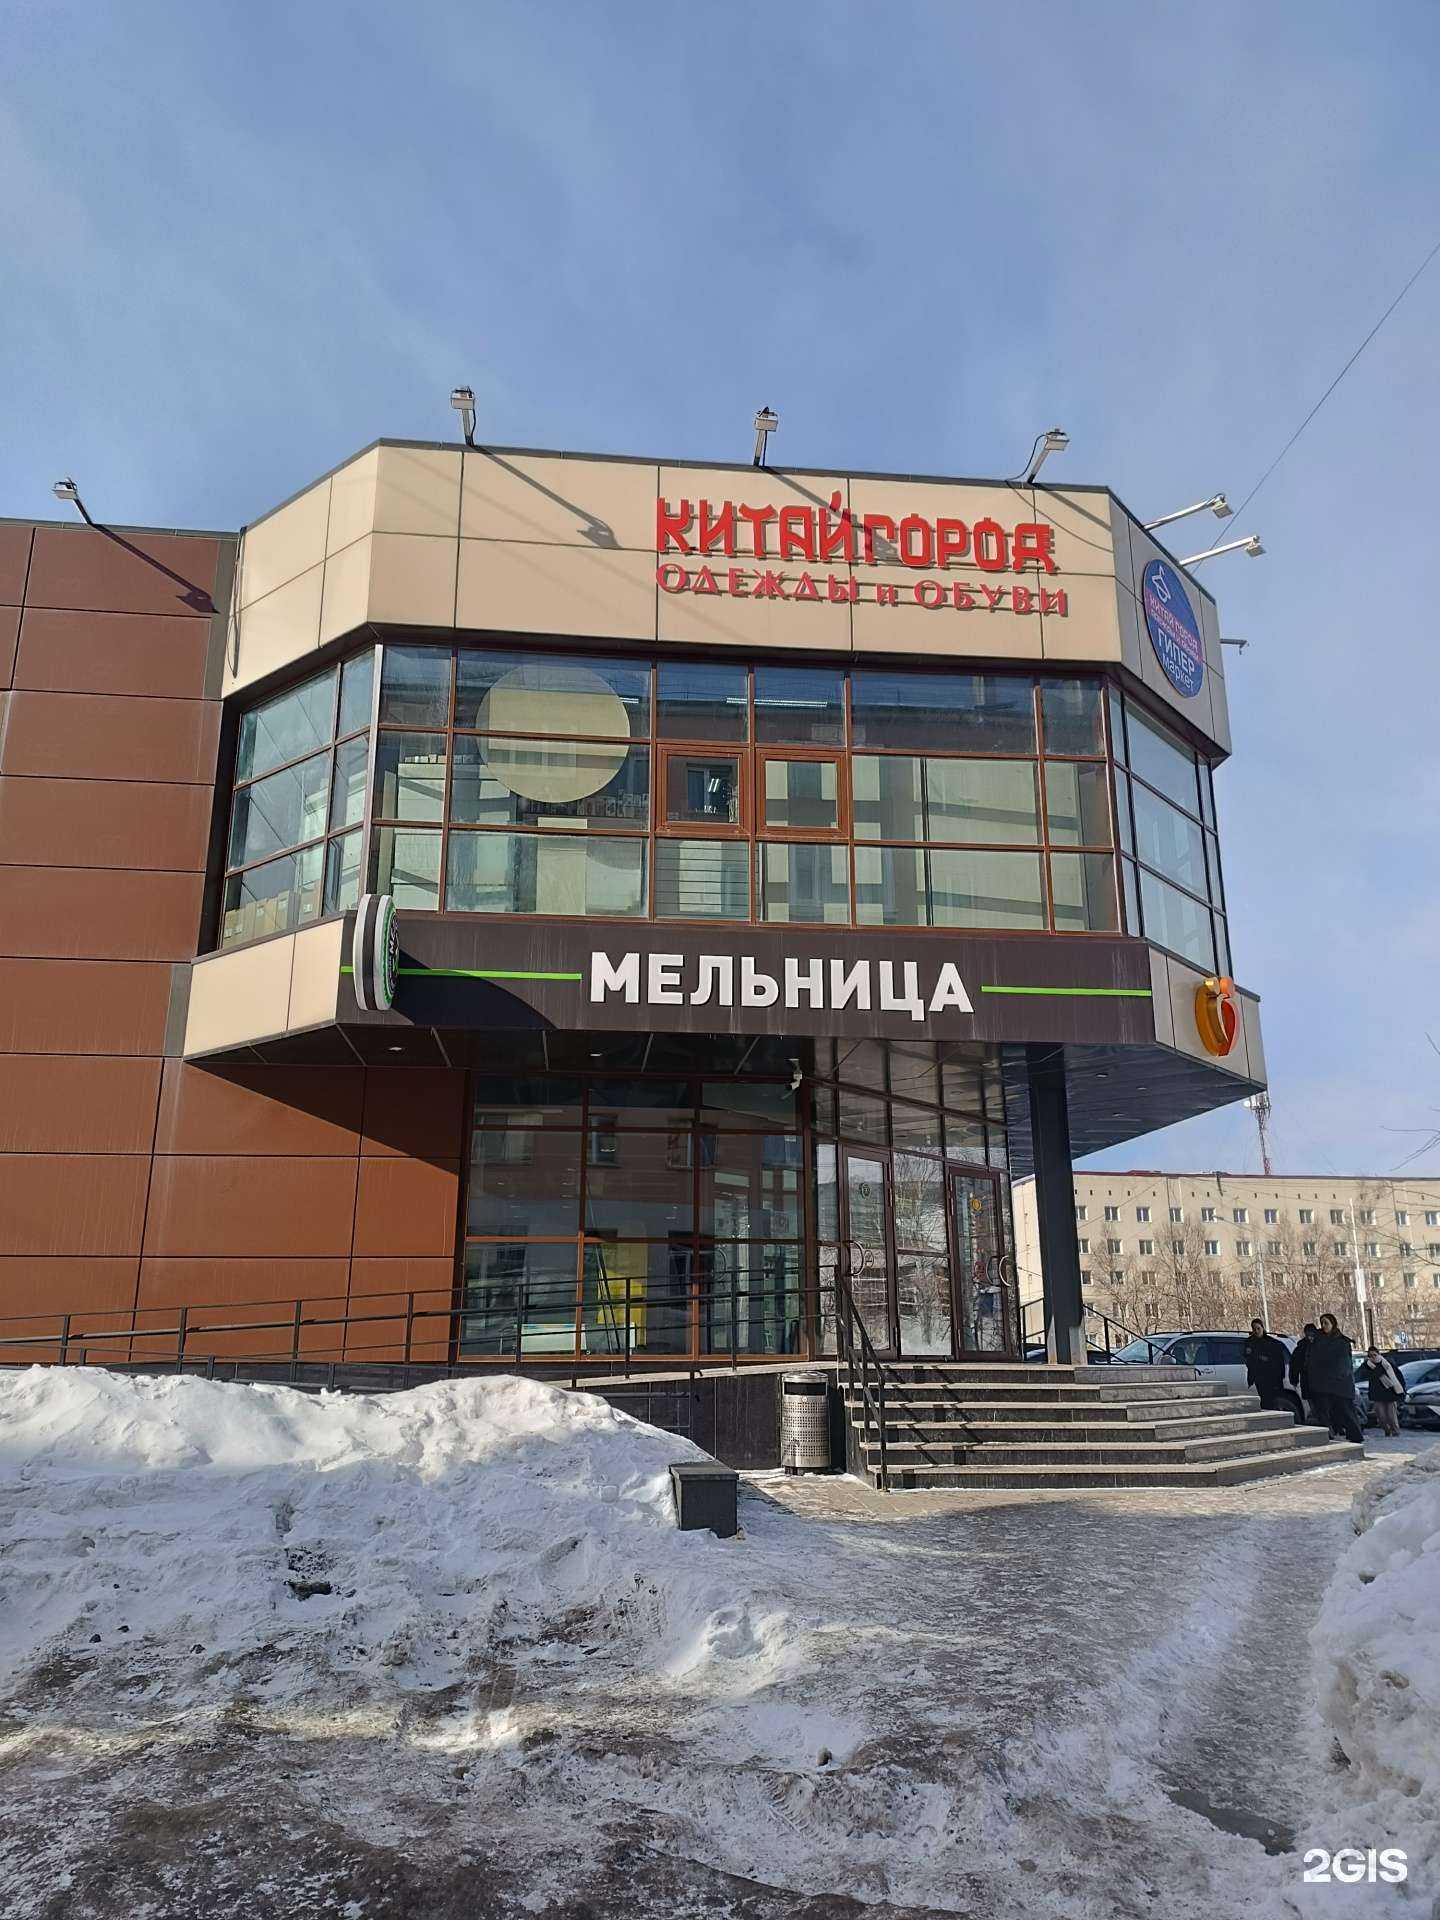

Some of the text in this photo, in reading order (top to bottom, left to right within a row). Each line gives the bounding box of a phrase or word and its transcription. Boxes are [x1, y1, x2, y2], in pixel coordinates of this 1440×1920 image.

[656, 563, 858, 603] ОДЕЖДЫ
[914, 579, 1068, 617] ОБУВИ
[1158, 627, 1195, 677] ГИПЕР
[590, 951, 975, 1022] МЕЛЬНИЦА
